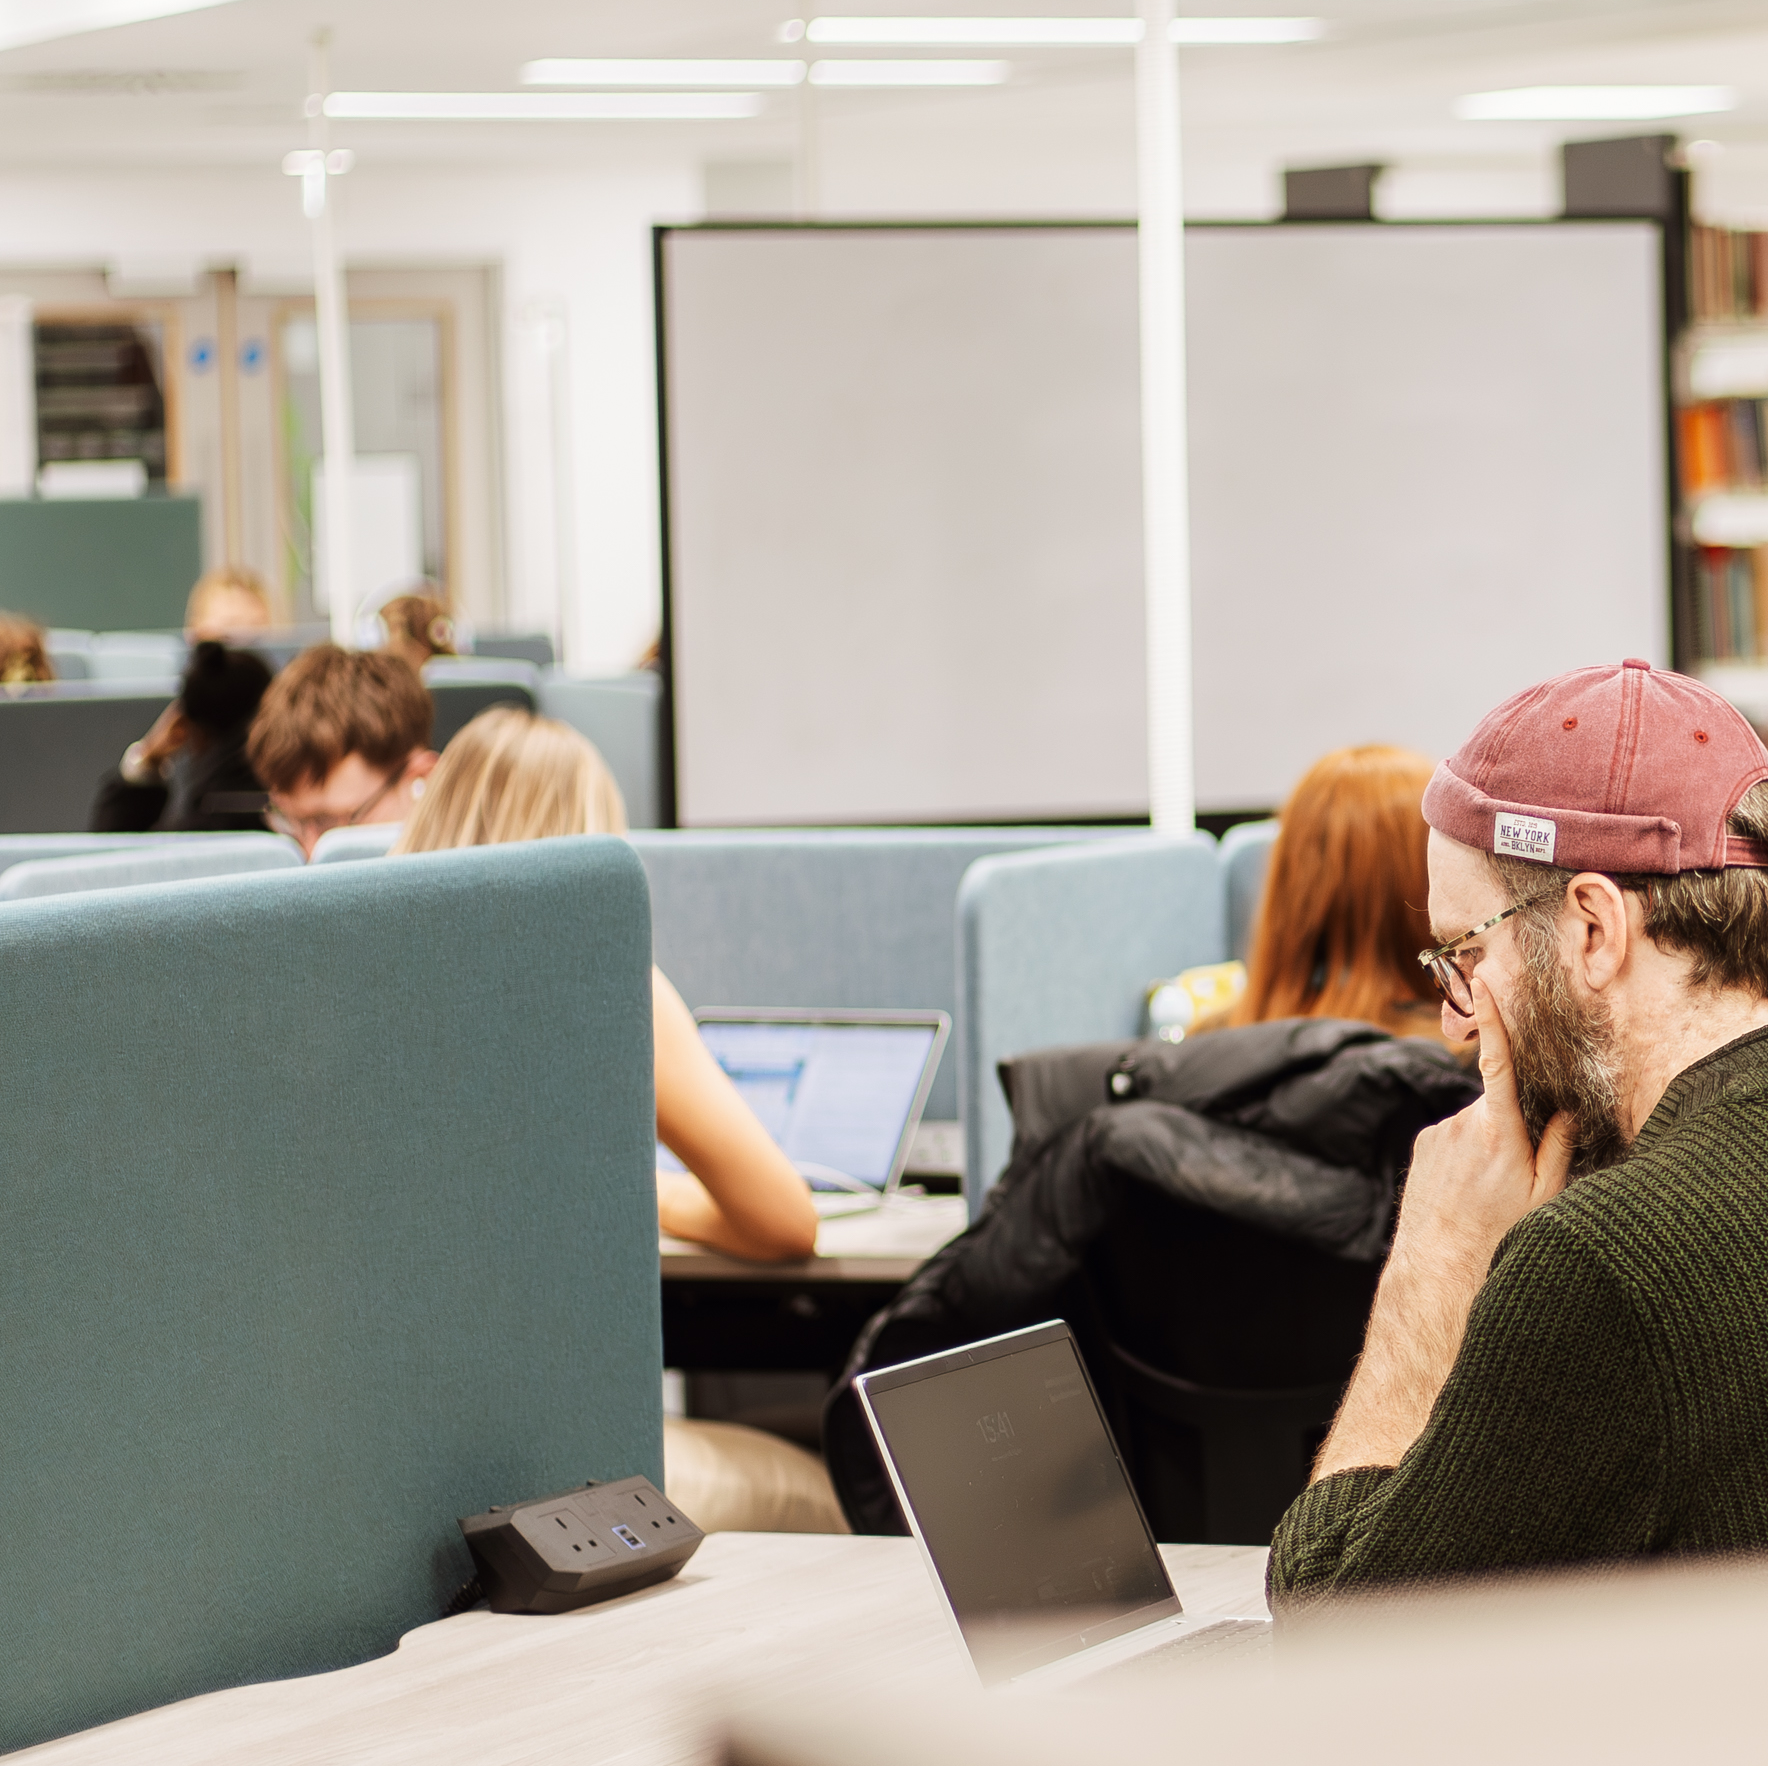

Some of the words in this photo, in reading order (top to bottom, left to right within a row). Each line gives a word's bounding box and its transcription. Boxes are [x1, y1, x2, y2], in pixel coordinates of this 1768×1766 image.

[1500, 825, 1521, 838] NEW
[1525, 828, 1550, 843] YORK
[1511, 840, 1535, 853] BKLYN
